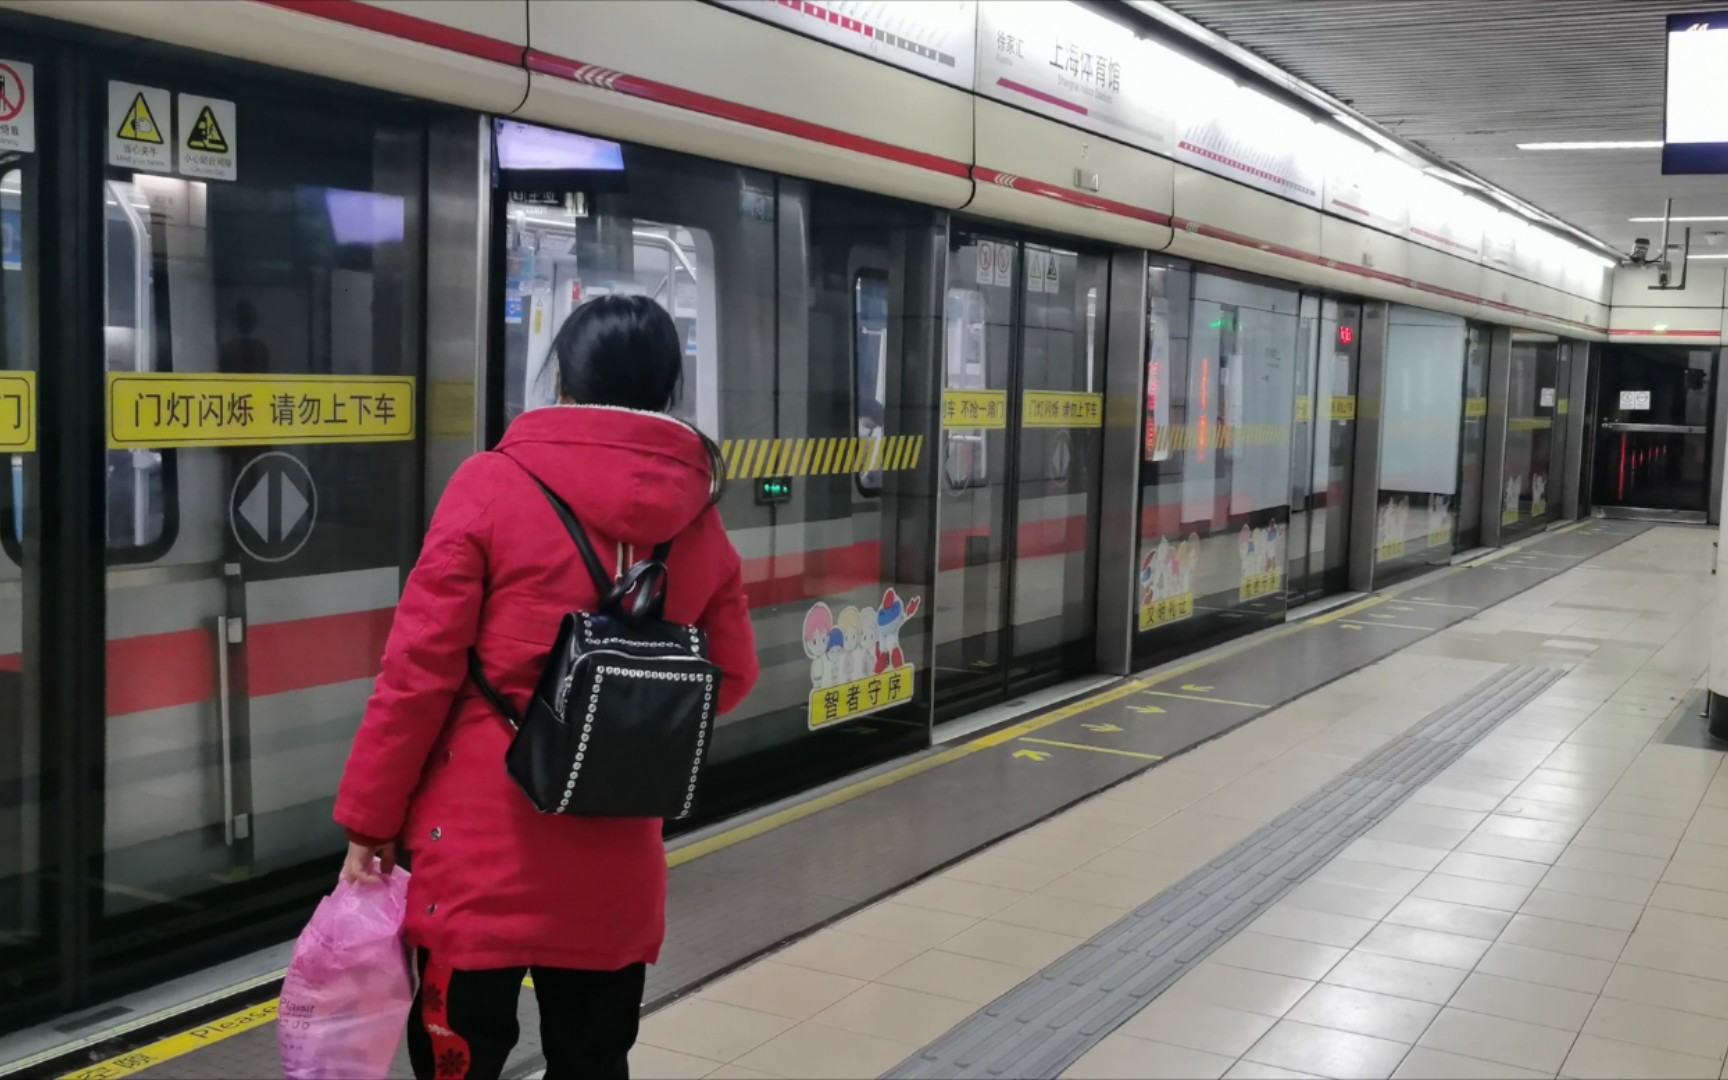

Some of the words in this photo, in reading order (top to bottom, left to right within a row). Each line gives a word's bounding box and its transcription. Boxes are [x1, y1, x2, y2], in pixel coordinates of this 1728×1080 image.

[1048, 35, 1120, 93] 上海体育馆
[134, 392, 254, 428] 门灯闪烁
[270, 393, 396, 427] 请勿上下车
[824, 673, 902, 720] 智者守序
